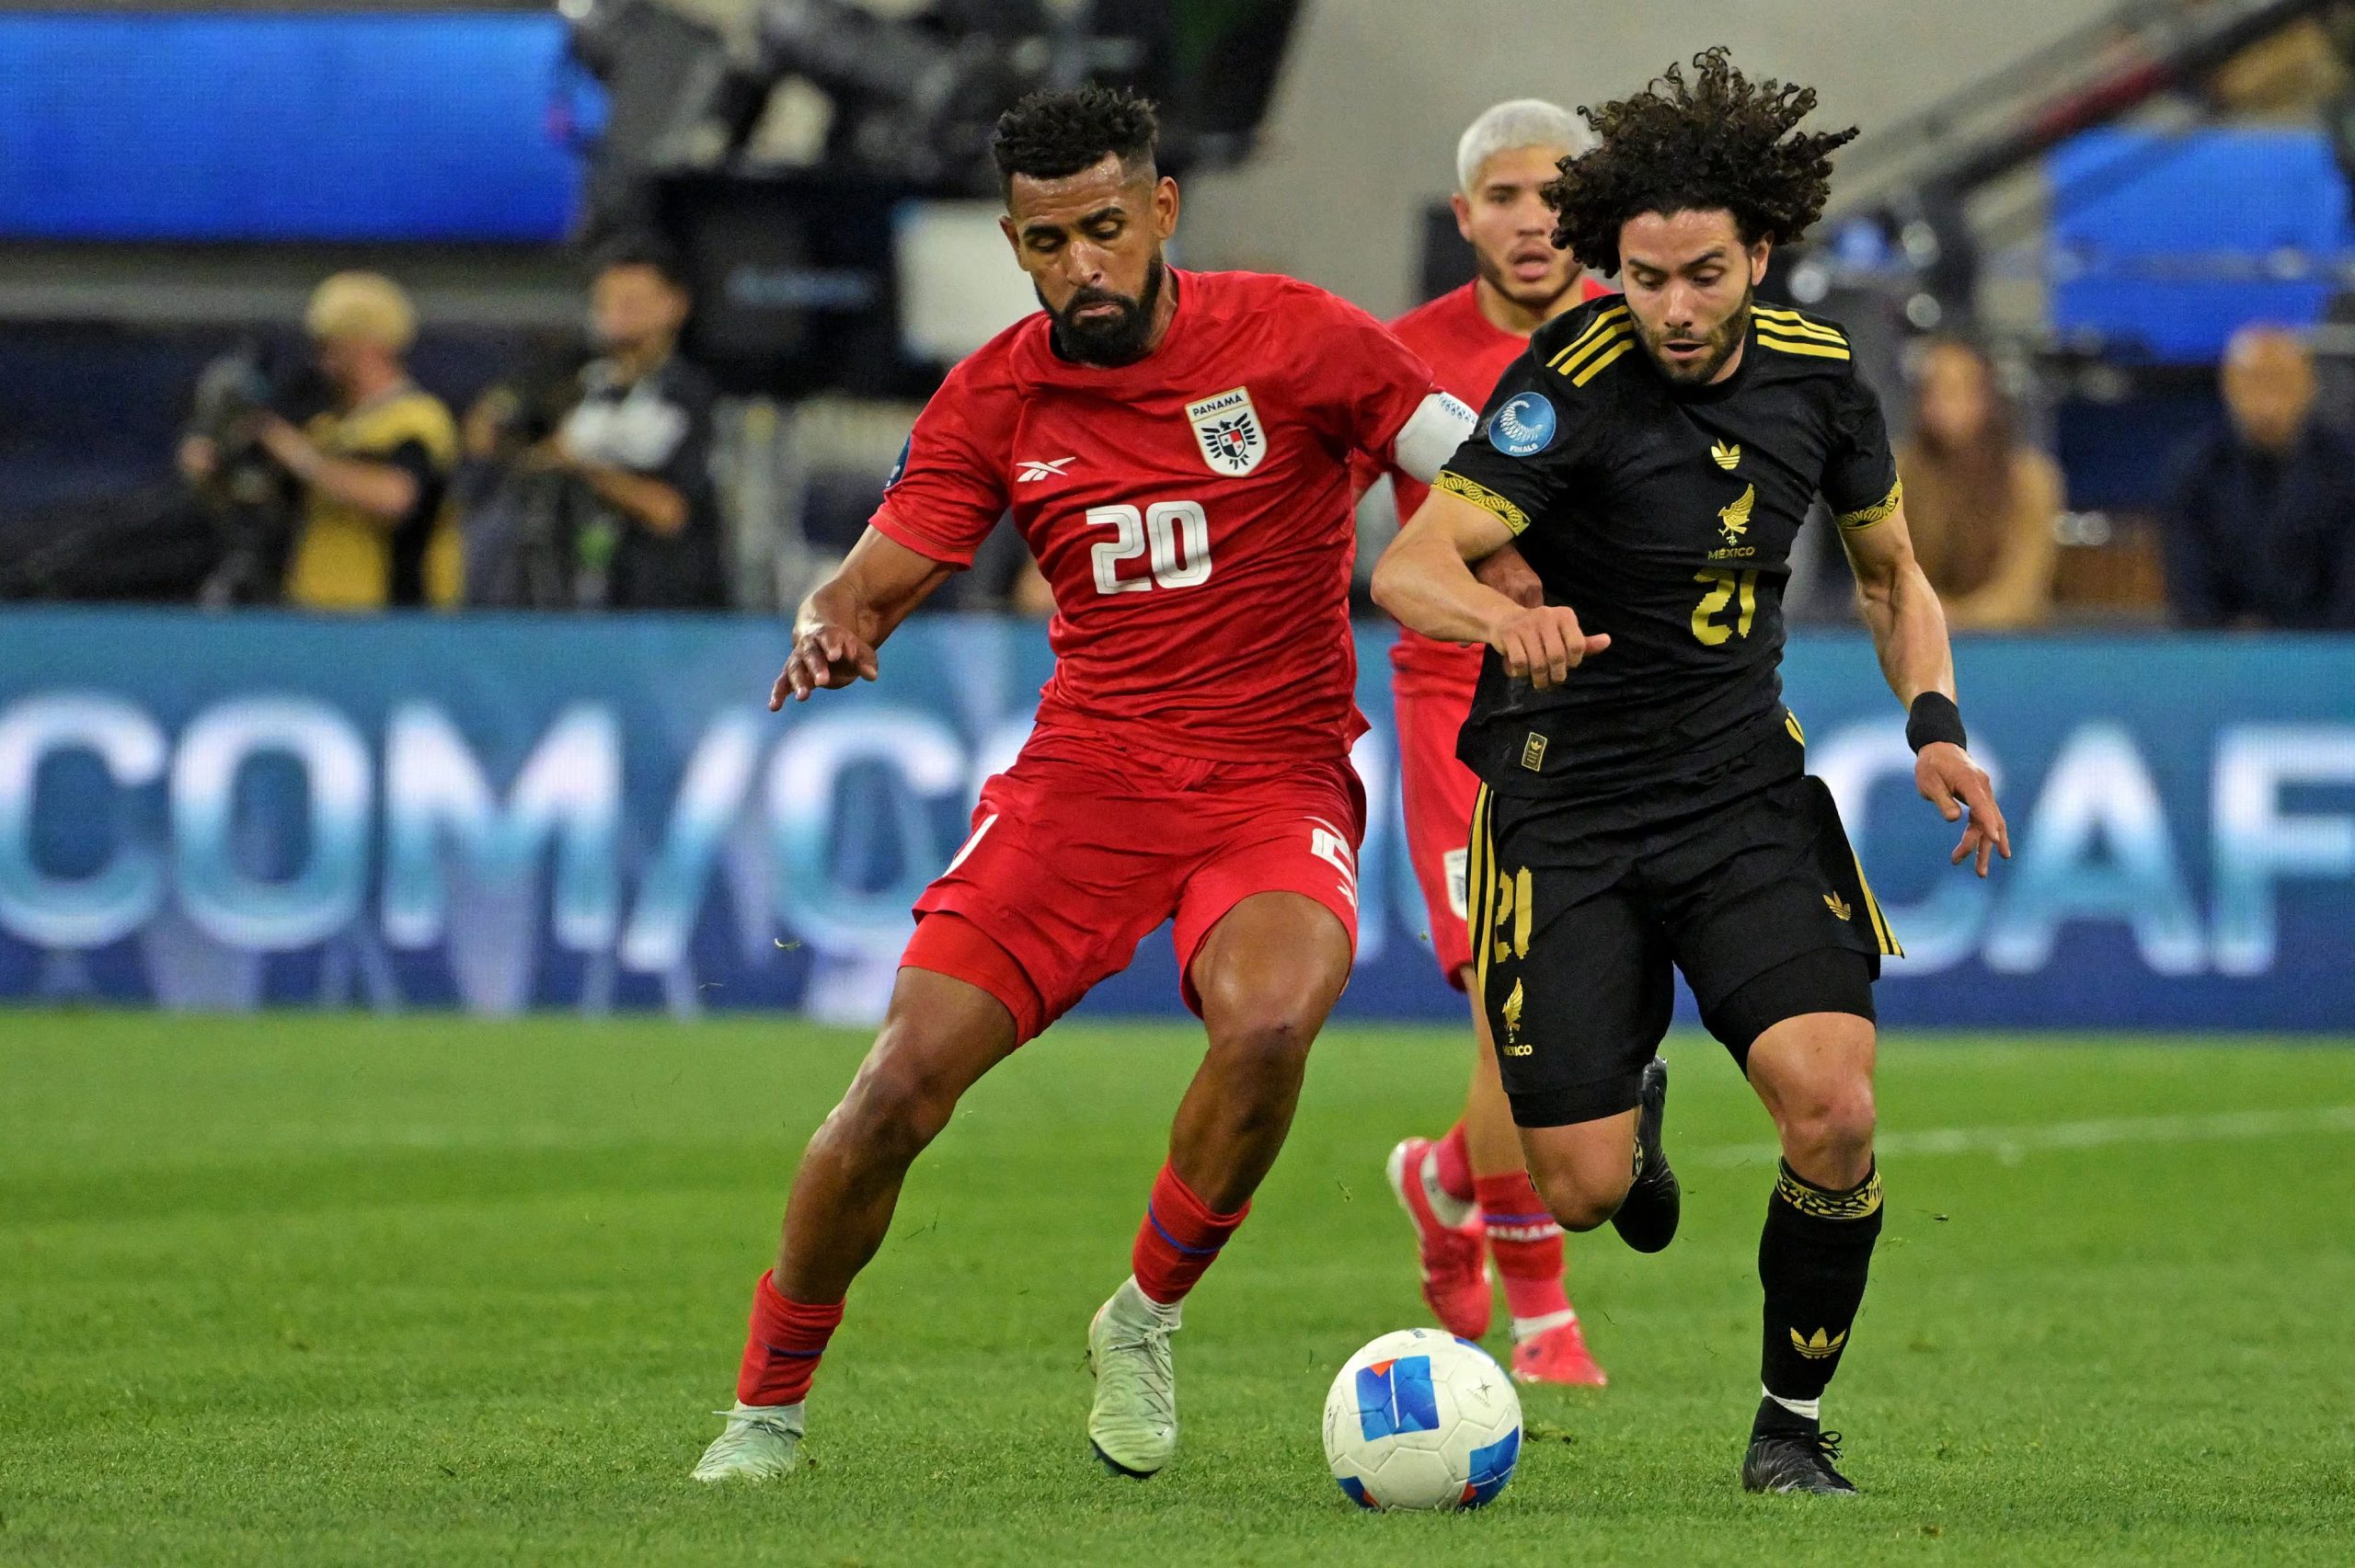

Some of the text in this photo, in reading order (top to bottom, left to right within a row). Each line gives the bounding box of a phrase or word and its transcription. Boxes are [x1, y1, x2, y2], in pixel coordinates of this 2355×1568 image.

[1509, 442, 1539, 453] FINALS
[1086, 500, 1212, 595] 20
[1691, 568, 1757, 647] 21
[1494, 866, 1533, 964] 21
